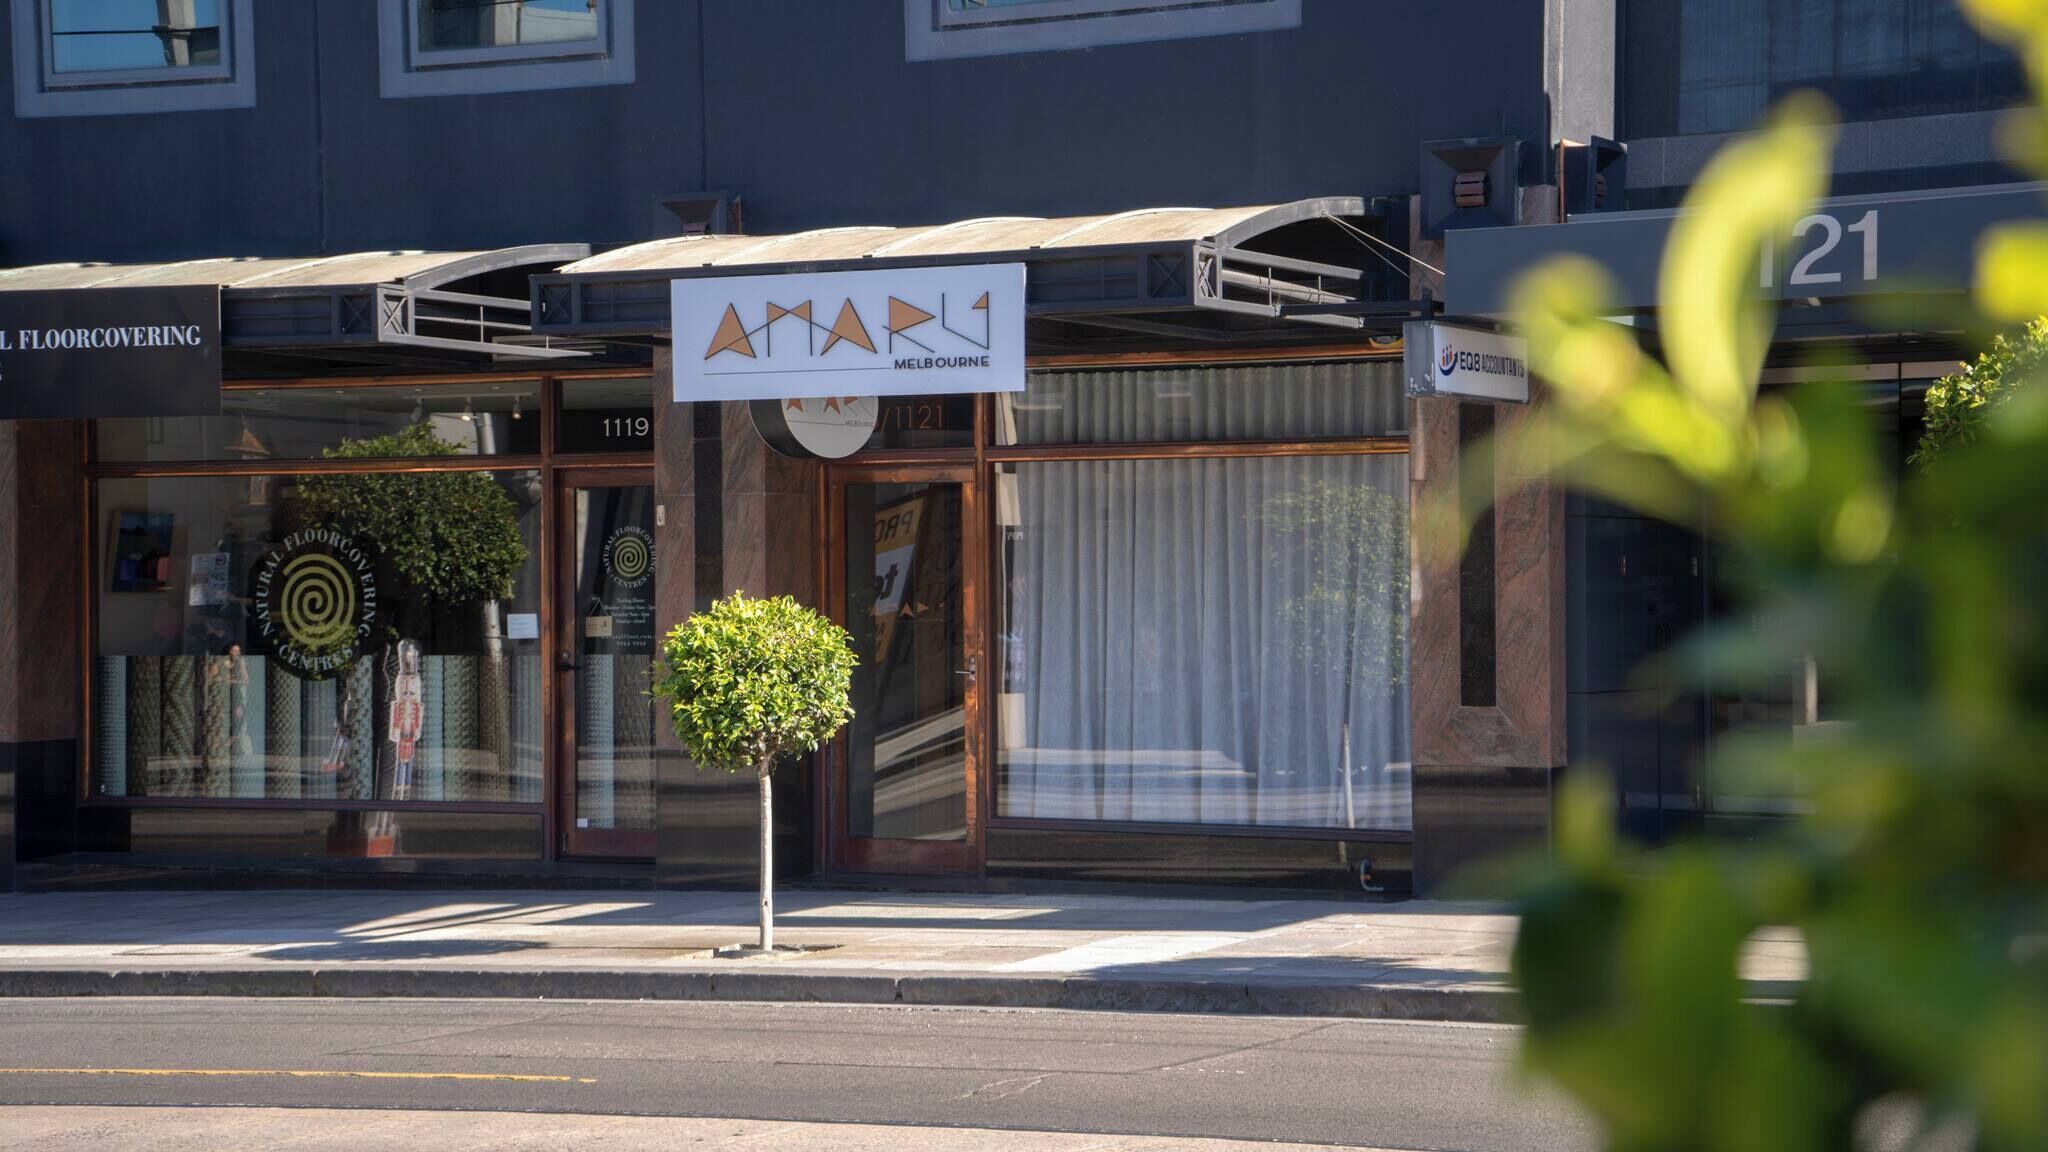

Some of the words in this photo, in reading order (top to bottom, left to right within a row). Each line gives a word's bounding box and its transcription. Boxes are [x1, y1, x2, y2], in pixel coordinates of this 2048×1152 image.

[19, 325, 201, 350] FLOORCOVERING
[894, 356, 990, 370] MELBOURNE
[1481, 354, 1525, 378] ACCOUNTANTS
[603, 417, 649, 437] 1119
[256, 551, 284, 637] NATURAL
[283, 527, 377, 637] FLOORCOVERING
